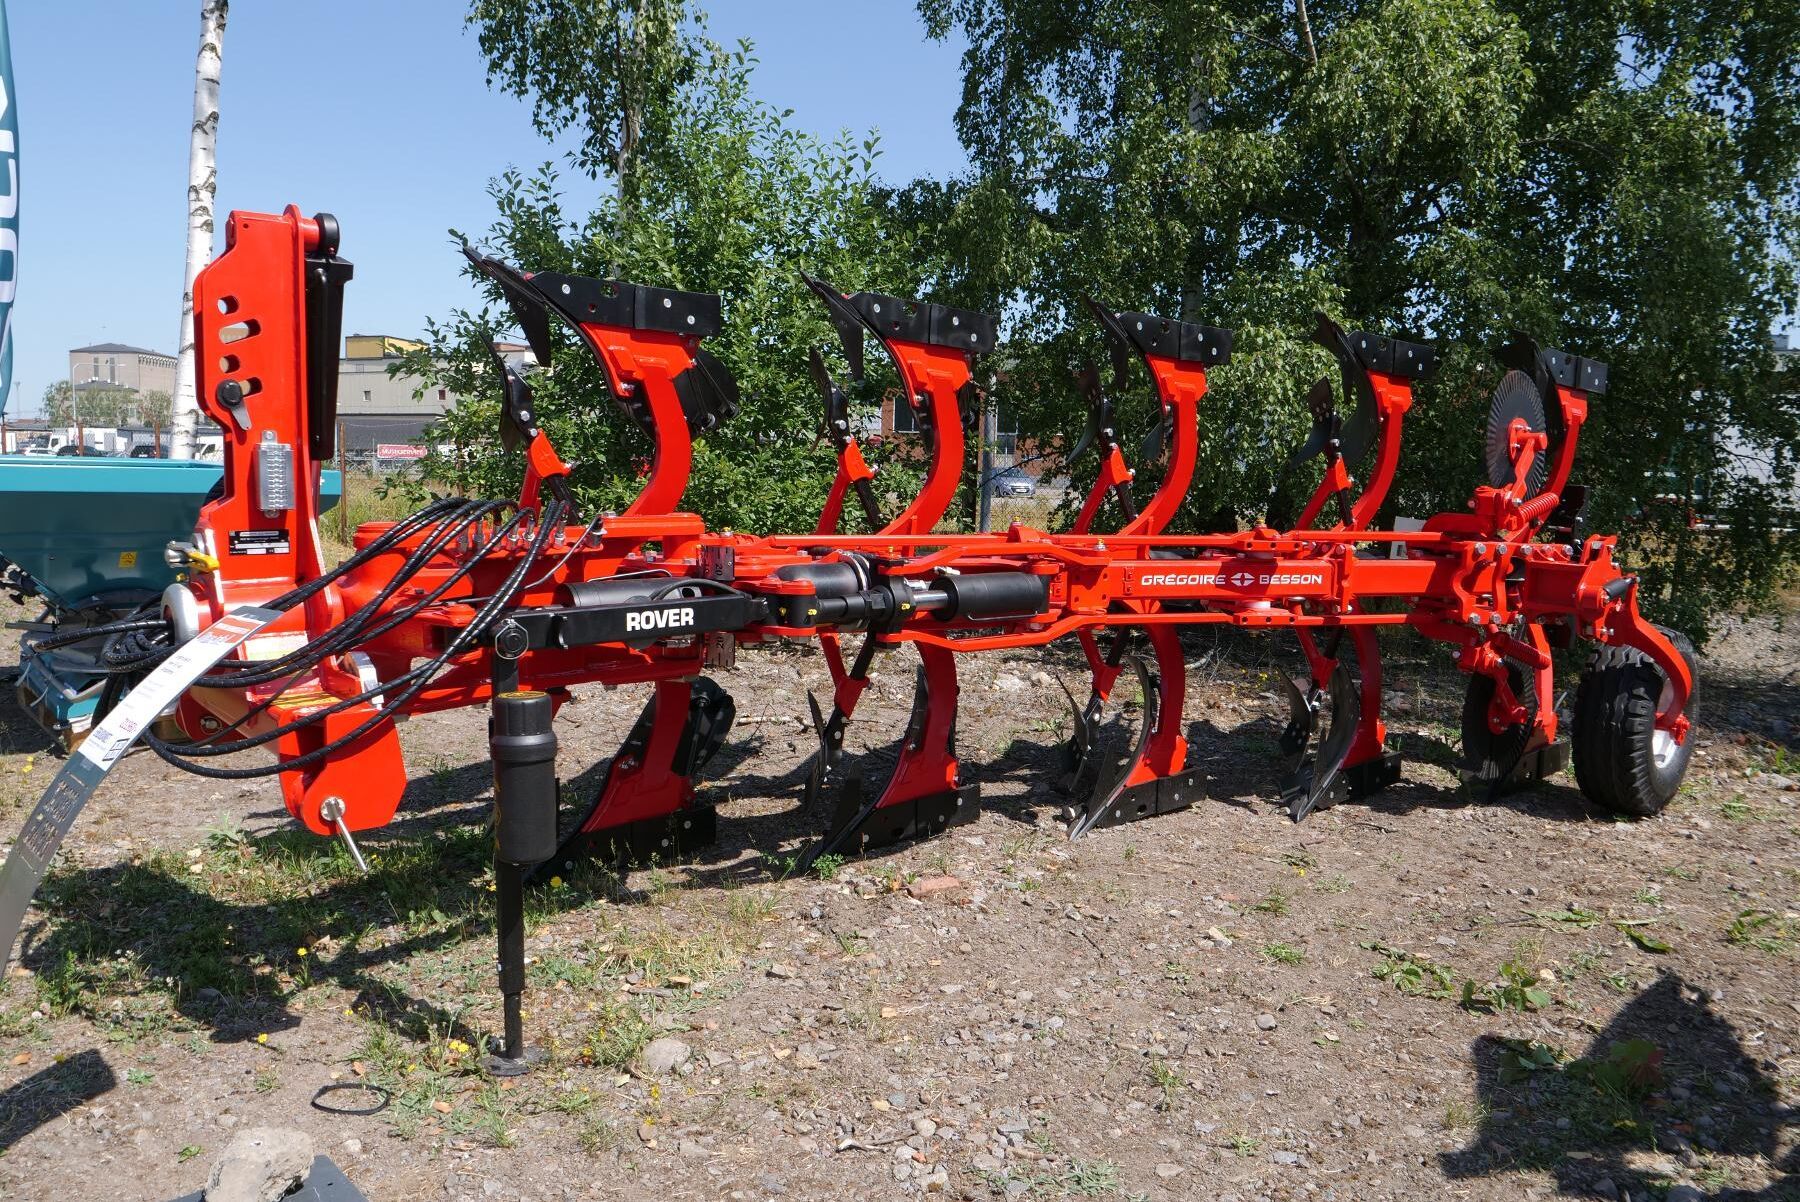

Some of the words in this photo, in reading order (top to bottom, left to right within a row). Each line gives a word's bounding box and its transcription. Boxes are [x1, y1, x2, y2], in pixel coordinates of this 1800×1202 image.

[1141, 573, 1226, 586] GRÉGOIRE
[1259, 574, 1322, 585] BESSON
[626, 607, 694, 632] ROVER
